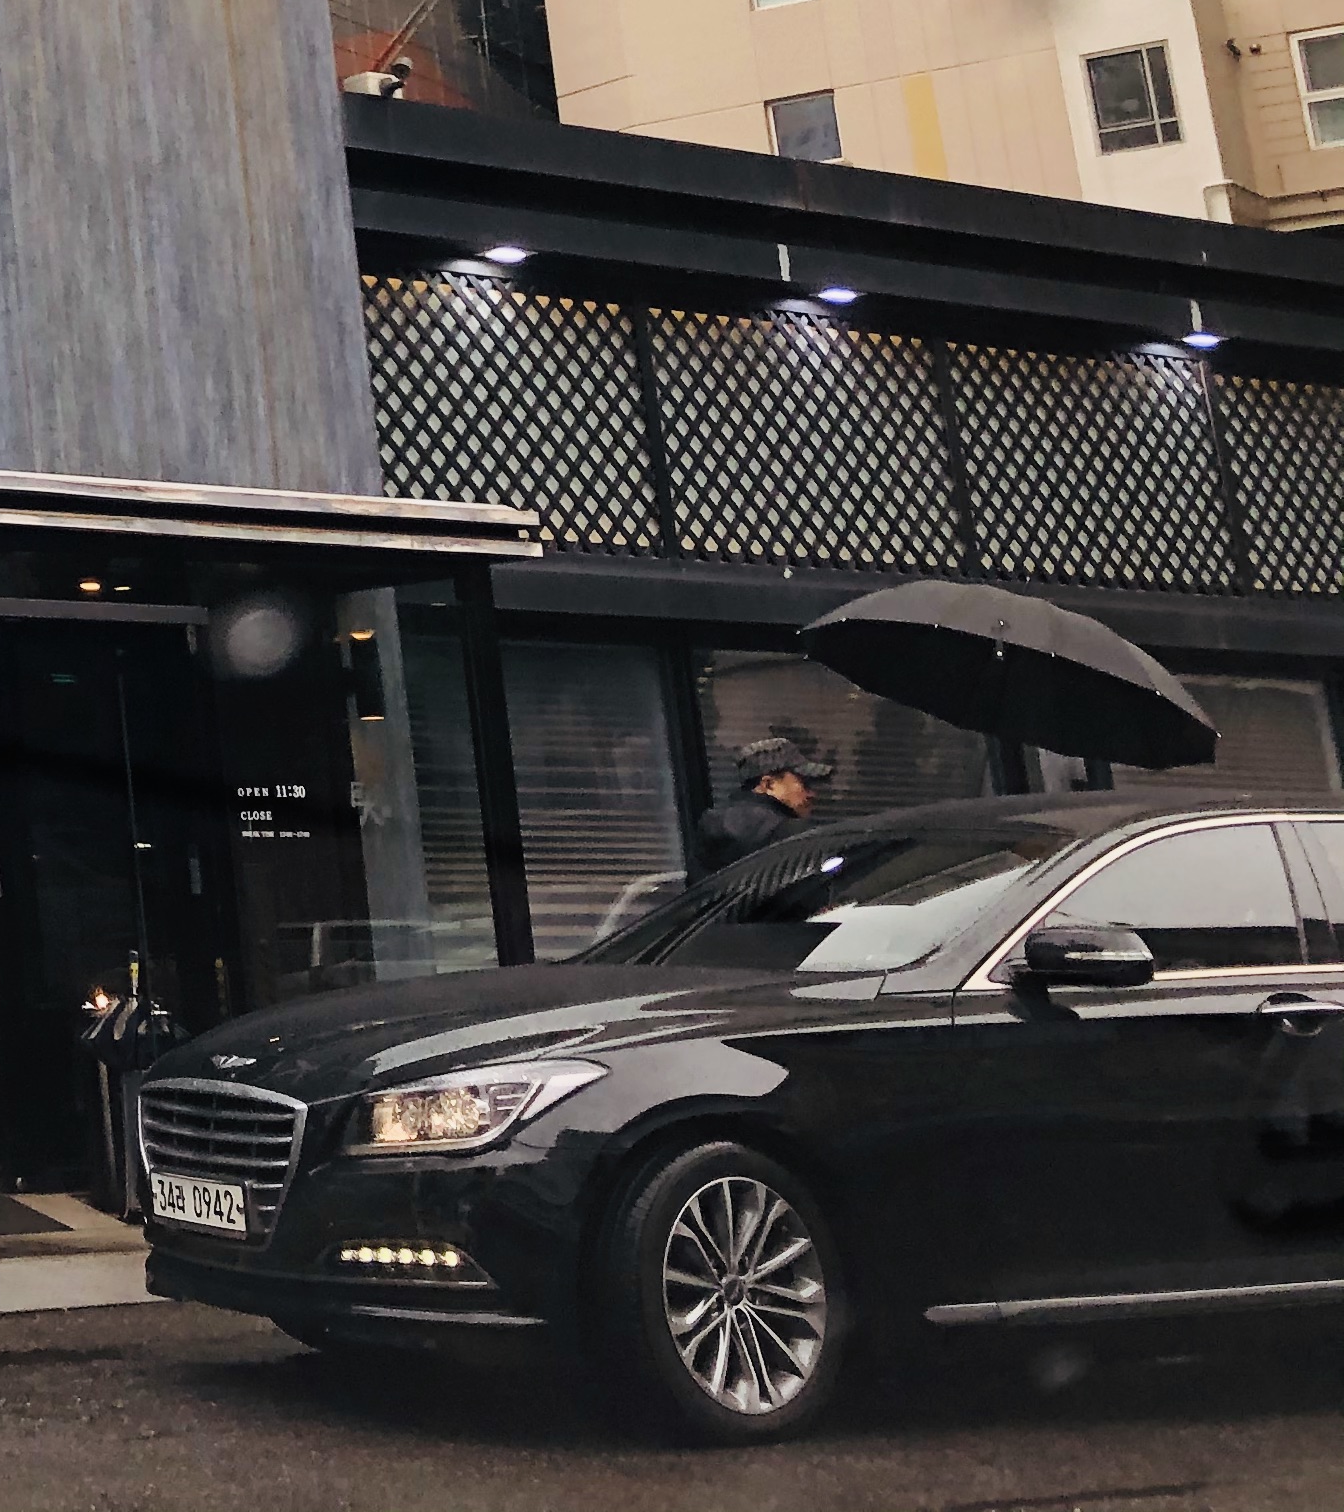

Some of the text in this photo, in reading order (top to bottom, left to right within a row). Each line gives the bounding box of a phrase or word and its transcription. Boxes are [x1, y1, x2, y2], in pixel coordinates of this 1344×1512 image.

[237, 784, 306, 798] OPEN 11:30
[240, 810, 273, 821] CLOSE
[192, 1184, 236, 1224] 0942
